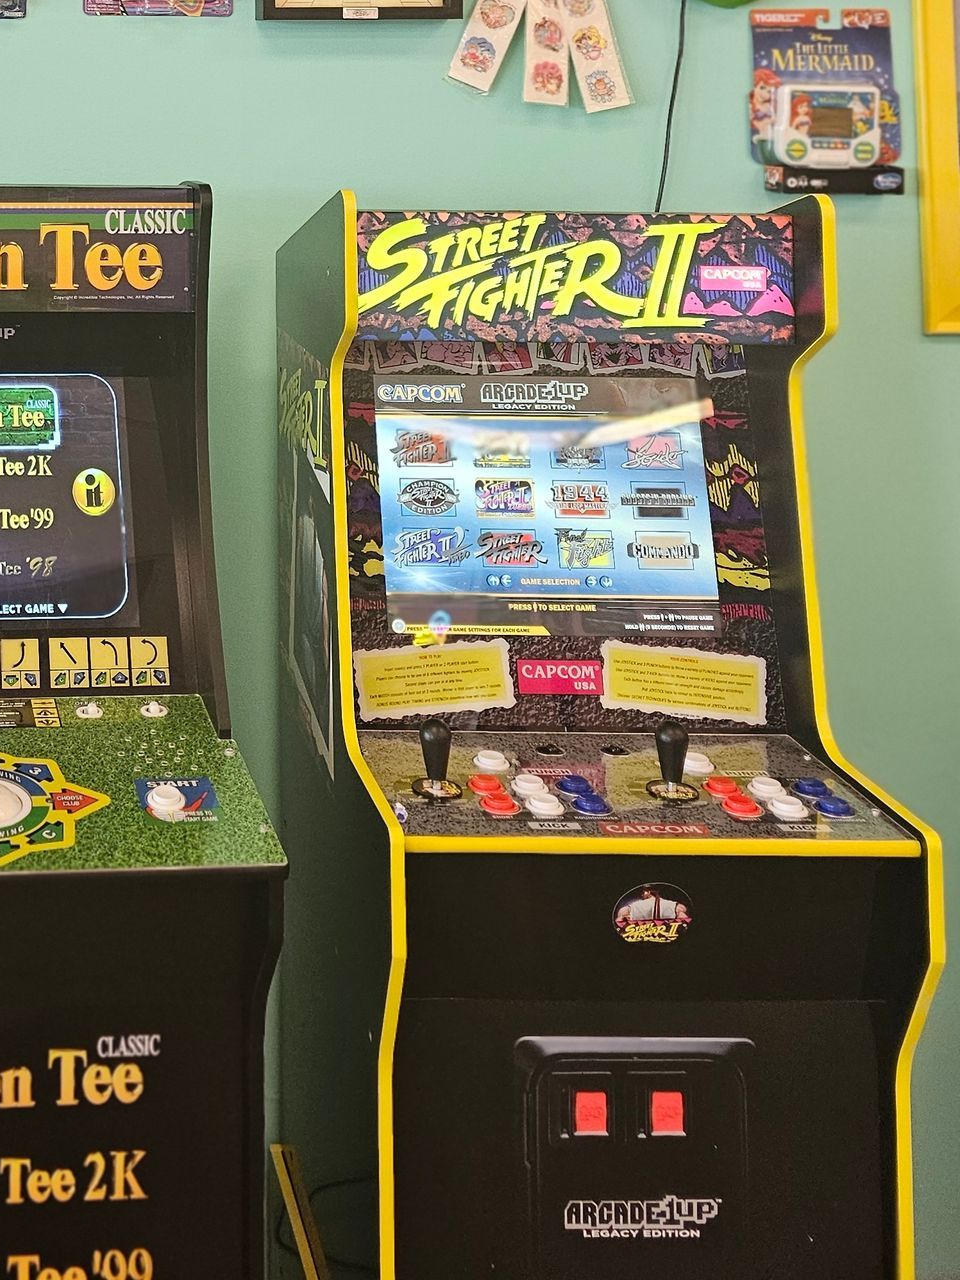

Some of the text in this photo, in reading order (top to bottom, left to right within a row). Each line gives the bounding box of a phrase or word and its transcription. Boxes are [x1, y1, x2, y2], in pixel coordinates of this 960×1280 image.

[771, 48, 875, 73] MERMAID
[103, 209, 187, 236] CLASSIC
[39, 222, 165, 292] Tee
[359, 214, 727, 329] STREET FIGHTER II
[703, 267, 765, 280] CAPCOM
[377, 384, 463, 403] CAPCOM
[26, 399, 52, 409] CLASSIC
[7, 407, 46, 427] Tee
[27, 455, 53, 476] 2K
[406, 480, 449, 493] CHAMPION
[551, 485, 609, 502] 1944
[411, 504, 448, 514] EDITION
[30, 507, 55, 529] '99
[632, 543, 695, 560] COMMANDO
[520, 577, 581, 586] GAME SELECTION
[24, 603, 54, 614] GAME
[508, 602, 597, 612] PRESS TO SELECT GAME
[521, 664, 596, 679] CAPCOM
[574, 682, 597, 690] USA
[146, 780, 200, 788] START
[538, 822, 570, 830] KICK
[605, 824, 705, 835] CAPCOM
[97, 1035, 160, 1058] CLASSIC
[48, 1048, 144, 1106] Tee
[0, 1157, 76, 1204] Tee
[84, 1150, 147, 1201] 2K
[583, 1228, 701, 1238] LEGACY EDITION
